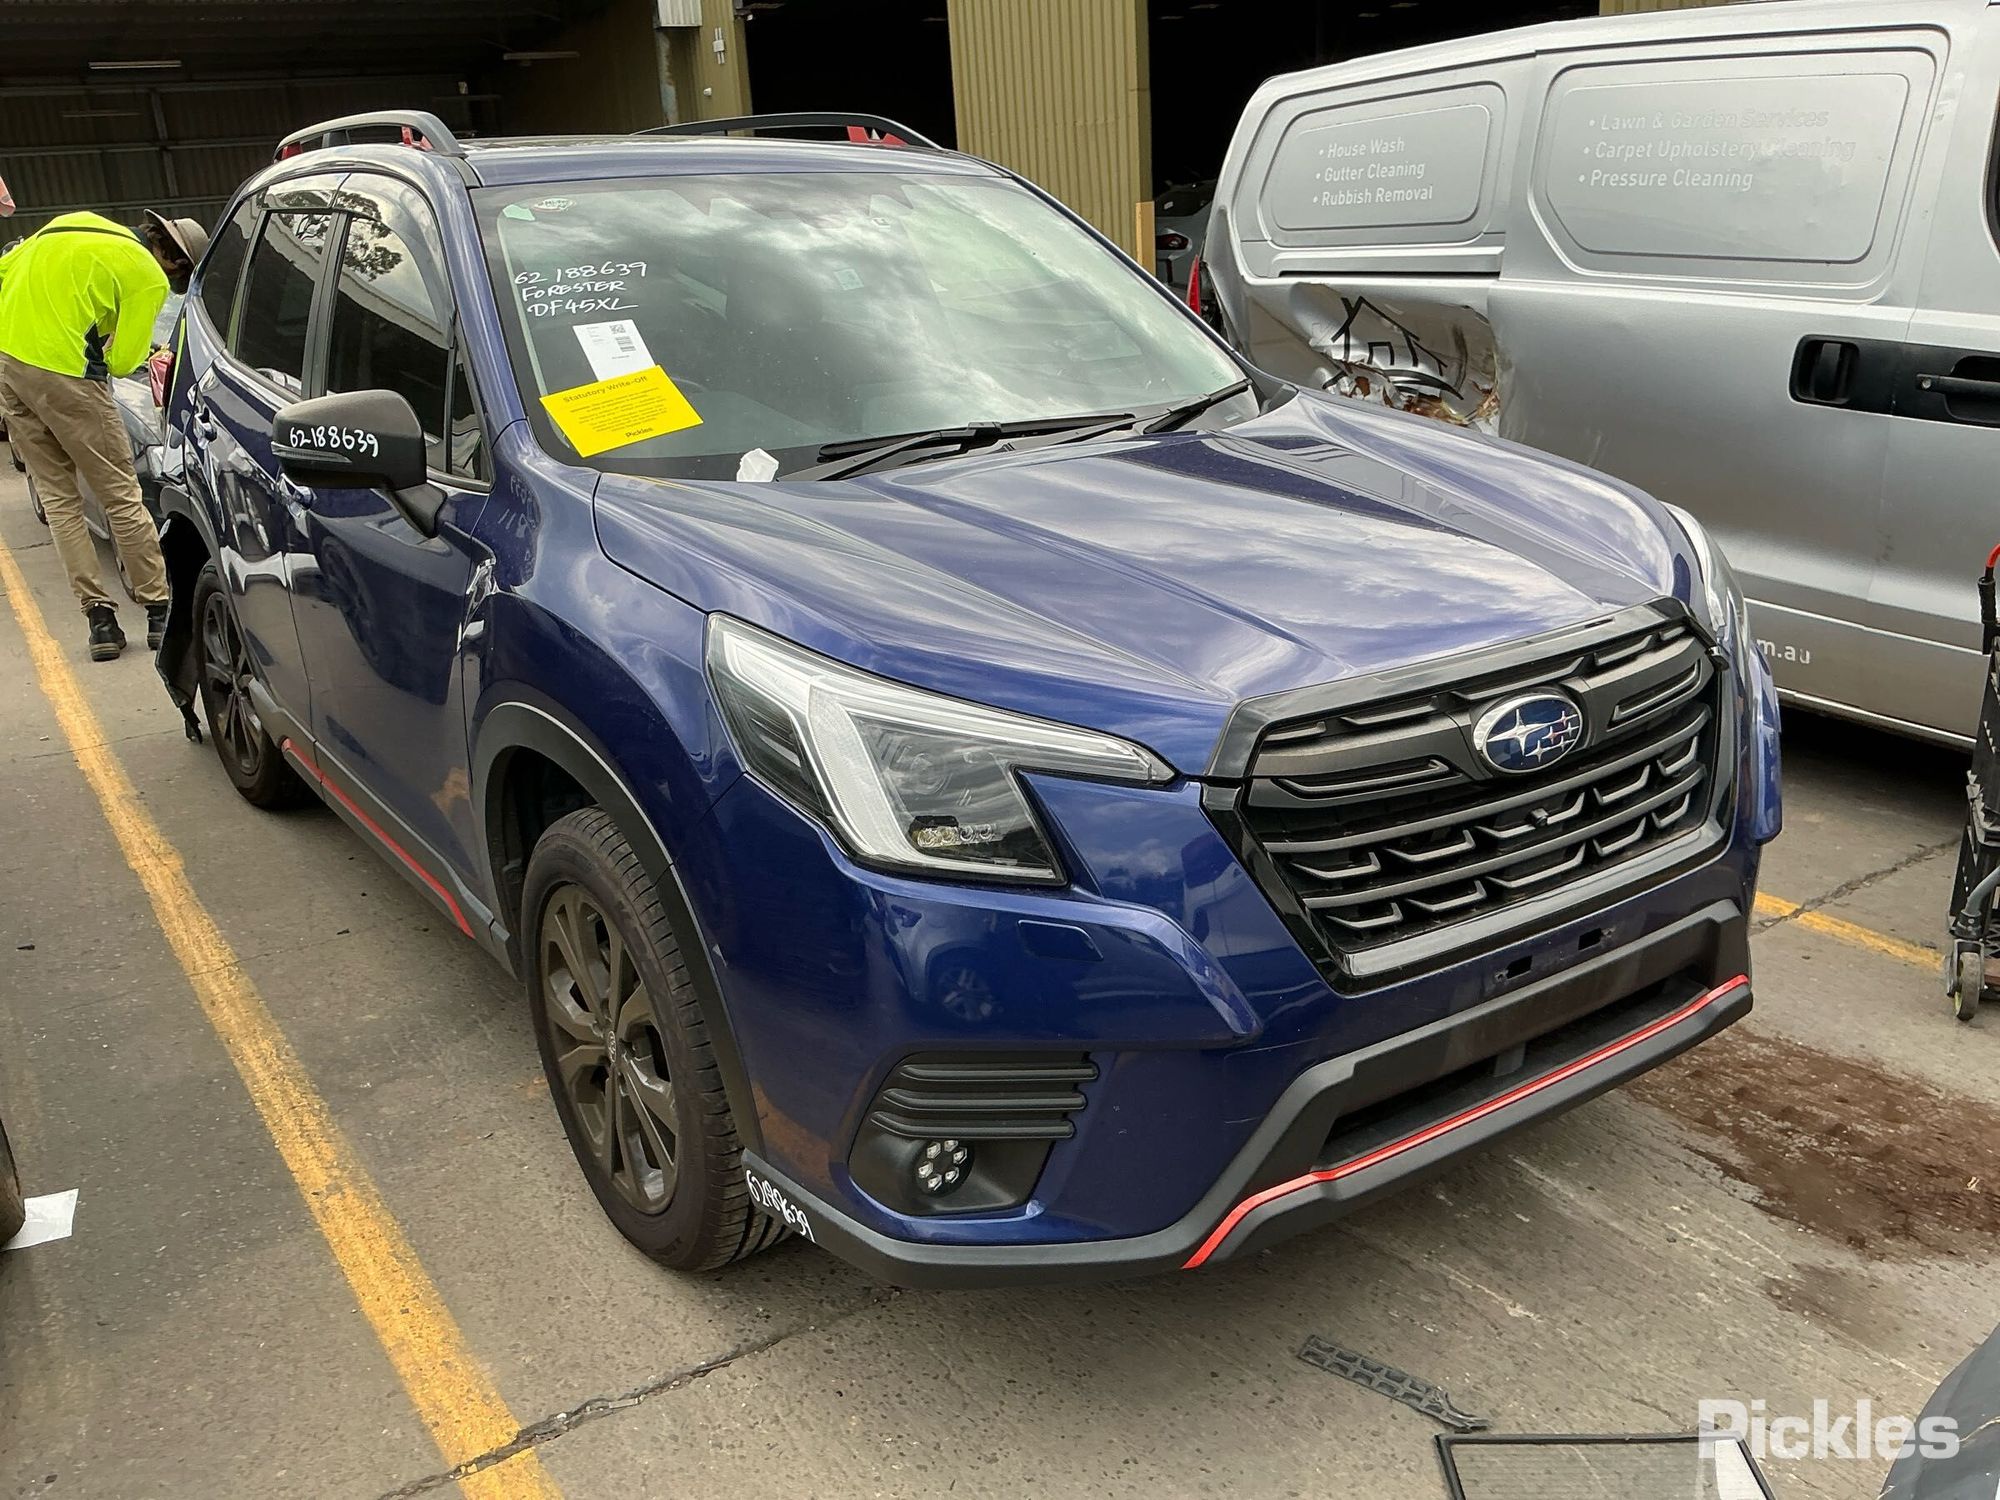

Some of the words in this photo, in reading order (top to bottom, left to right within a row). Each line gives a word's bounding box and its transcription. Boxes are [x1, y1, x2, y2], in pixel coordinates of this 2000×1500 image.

[1600, 114, 1646, 130] Lawn
[1652, 111, 1664, 129] &
[1671, 109, 1737, 129] Garden
[1327, 142, 1366, 158] House
[1370, 136, 1405, 154] Wash
[1595, 141, 1652, 162] Carpet
[1658, 140, 1759, 162] Upholstery
[1324, 167, 1364, 182] Gutter
[1367, 161, 1425, 179] Cleaning
[1590, 169, 1667, 187] Pressure
[1672, 168, 1754, 192] Cleaning
[1321, 189, 1372, 206] Rubbish
[1375, 186, 1433, 203] Removal
[514, 271, 549, 285] 62
[556, 261, 647, 283] 188639
[527, 297, 639, 317] DF45XL
[562, 386, 606, 403] Statutory
[606, 375, 648, 391] Write-Off
[625, 427, 653, 438] Pickles
[1756, 638, 1810, 664] m.au
